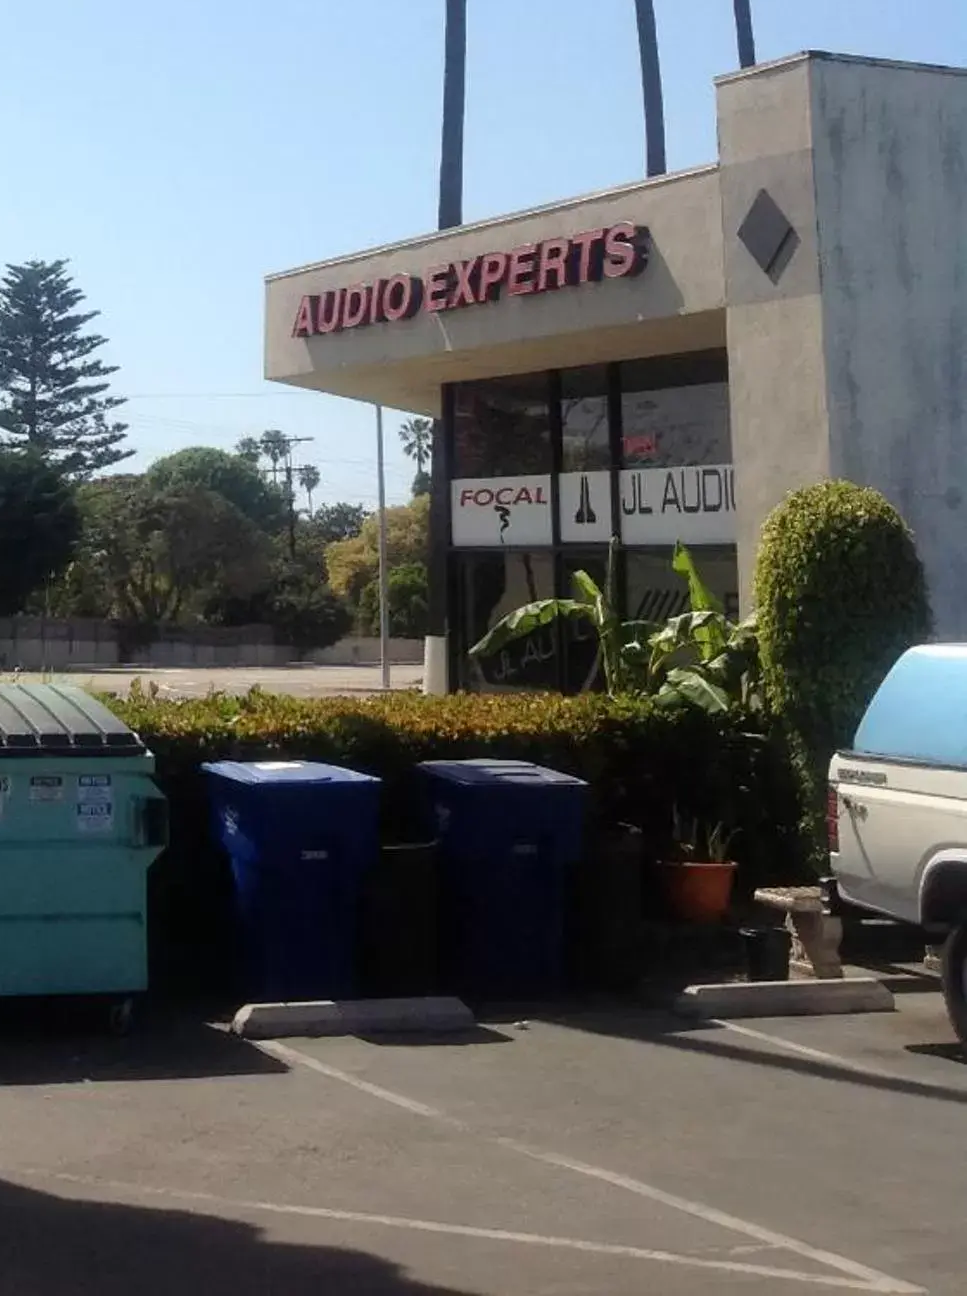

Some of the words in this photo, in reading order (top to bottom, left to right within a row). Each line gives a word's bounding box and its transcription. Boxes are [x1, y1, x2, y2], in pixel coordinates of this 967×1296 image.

[292, 273, 416, 338] AUDIO
[422, 220, 643, 312] EXPERTS
[460, 487, 548, 507] FOCAL
[622, 473, 653, 515] JL
[662, 468, 736, 513] AUDI
